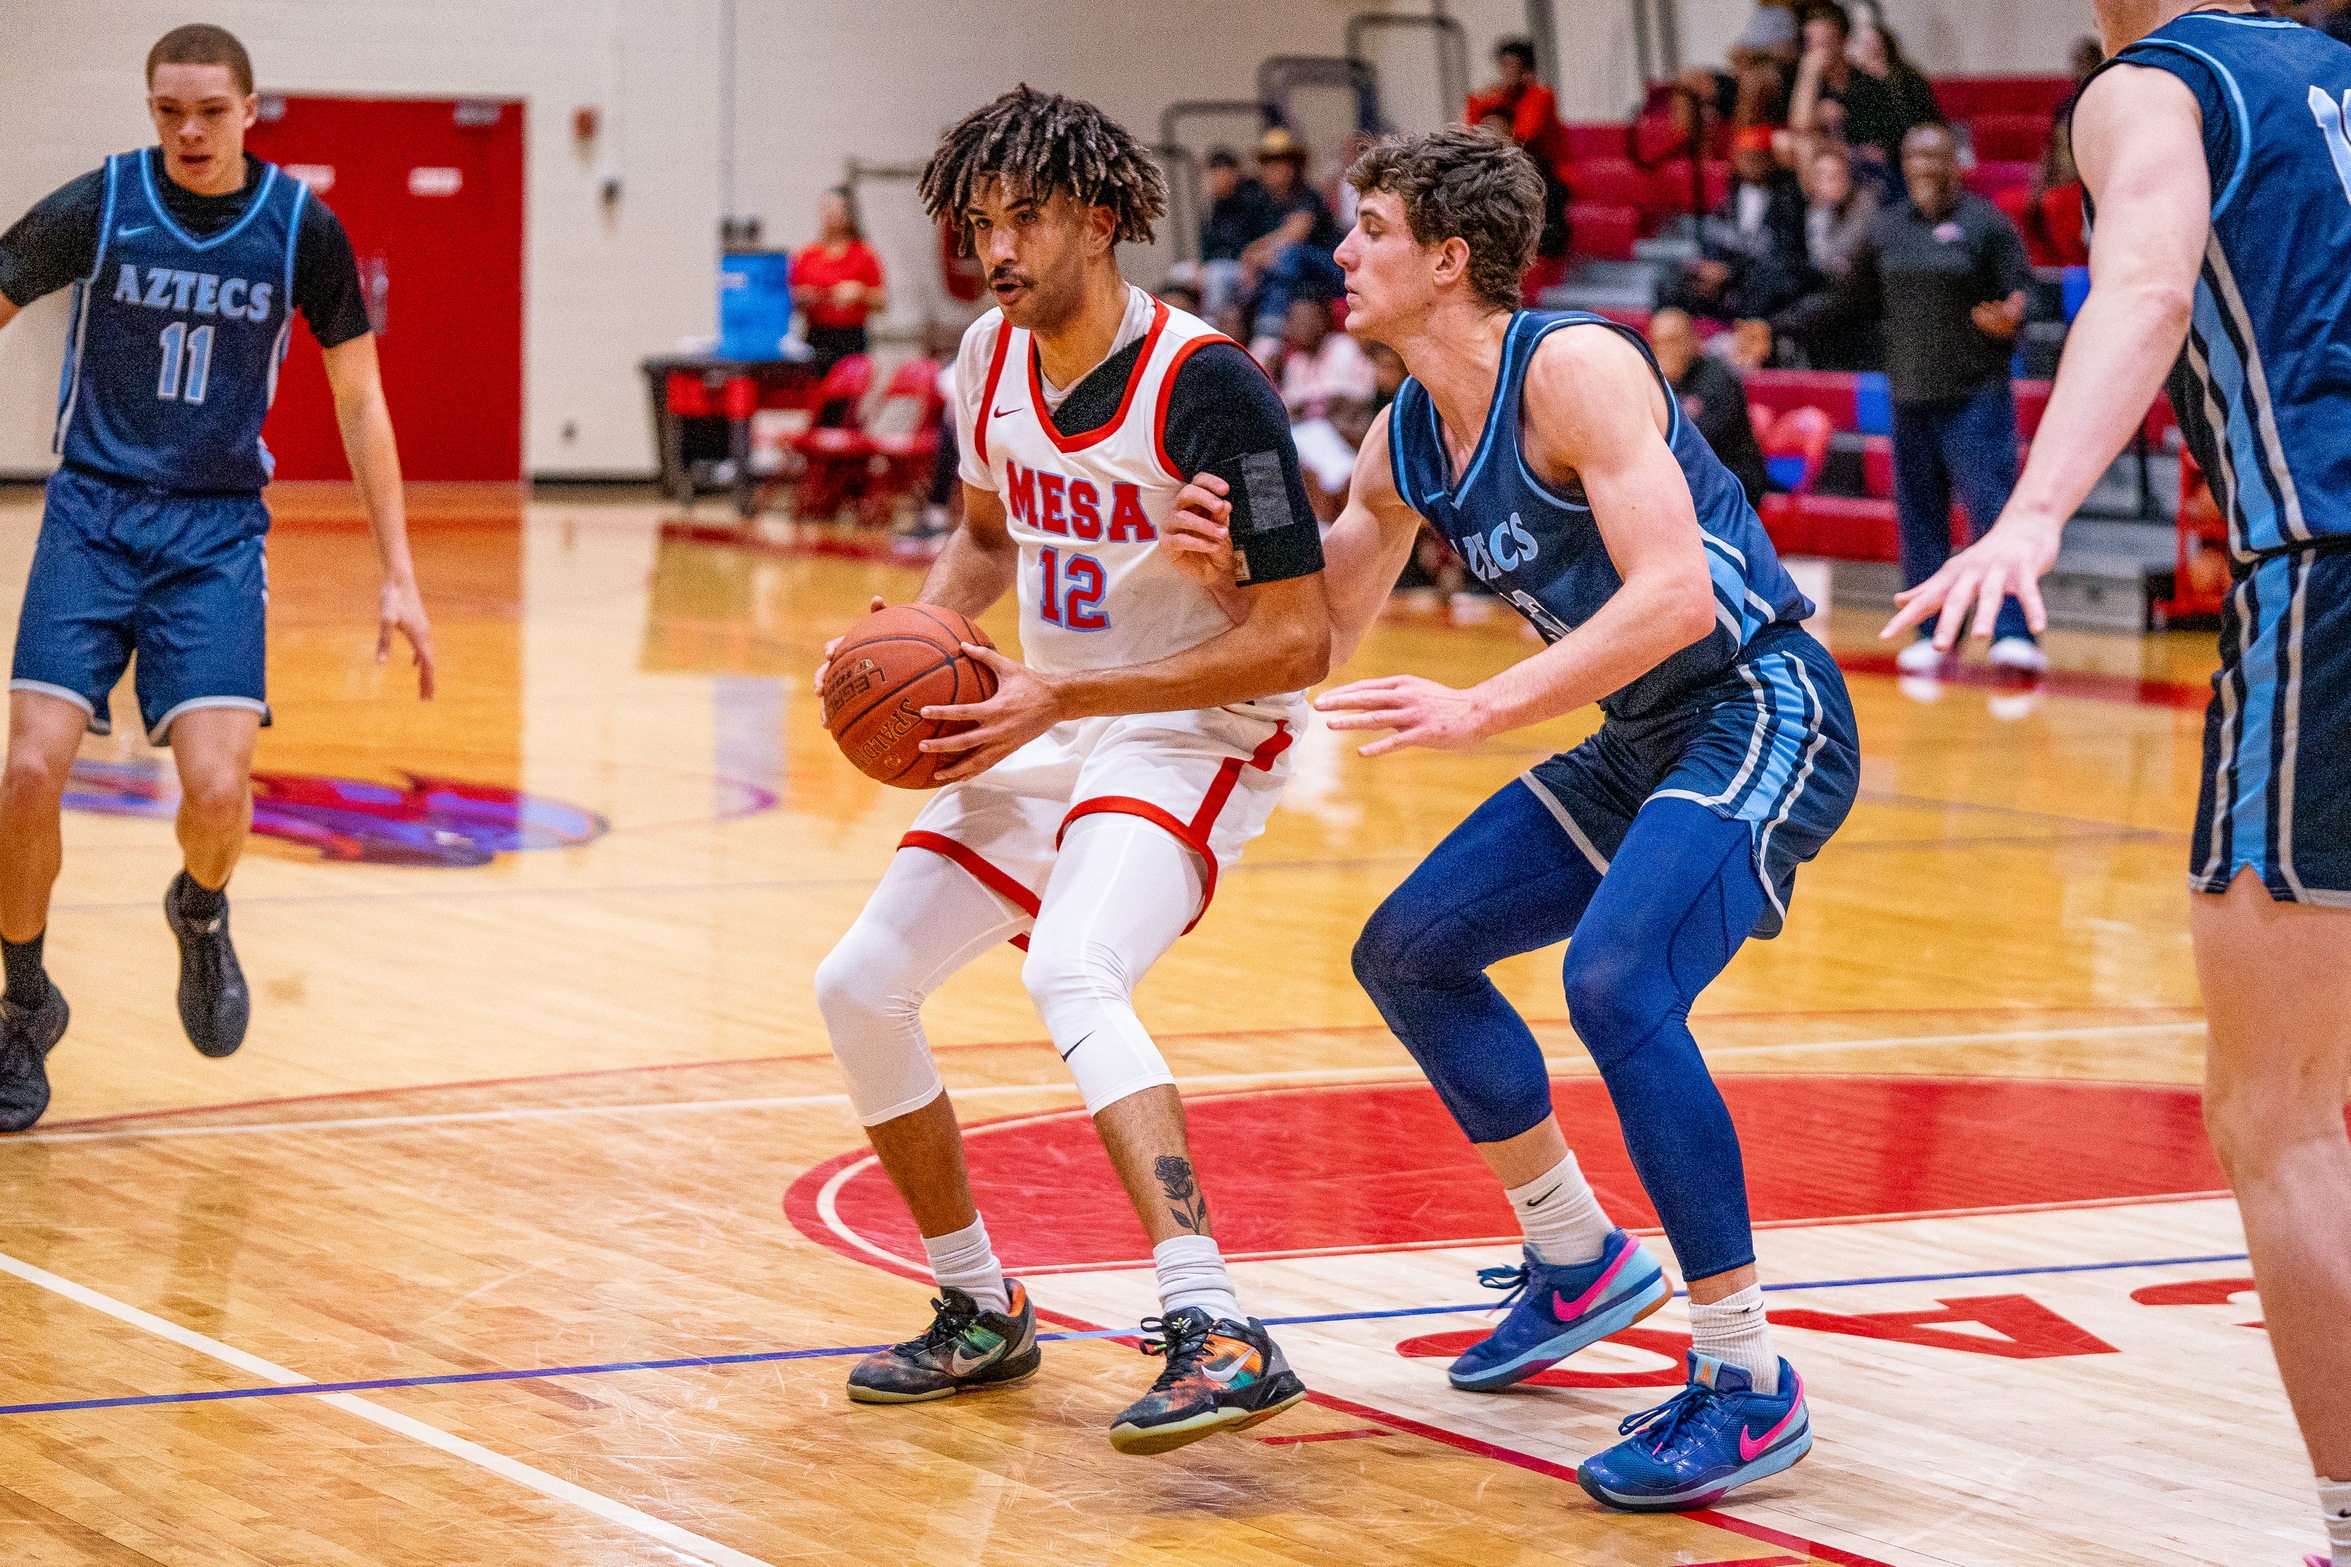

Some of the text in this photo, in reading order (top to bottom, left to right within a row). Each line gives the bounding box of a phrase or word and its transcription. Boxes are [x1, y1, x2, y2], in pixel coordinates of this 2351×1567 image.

[113, 263, 274, 322] AZTECS
[157, 321, 216, 404] 11
[1006, 457, 1159, 543] MESA
[1039, 544, 1112, 633] 12
